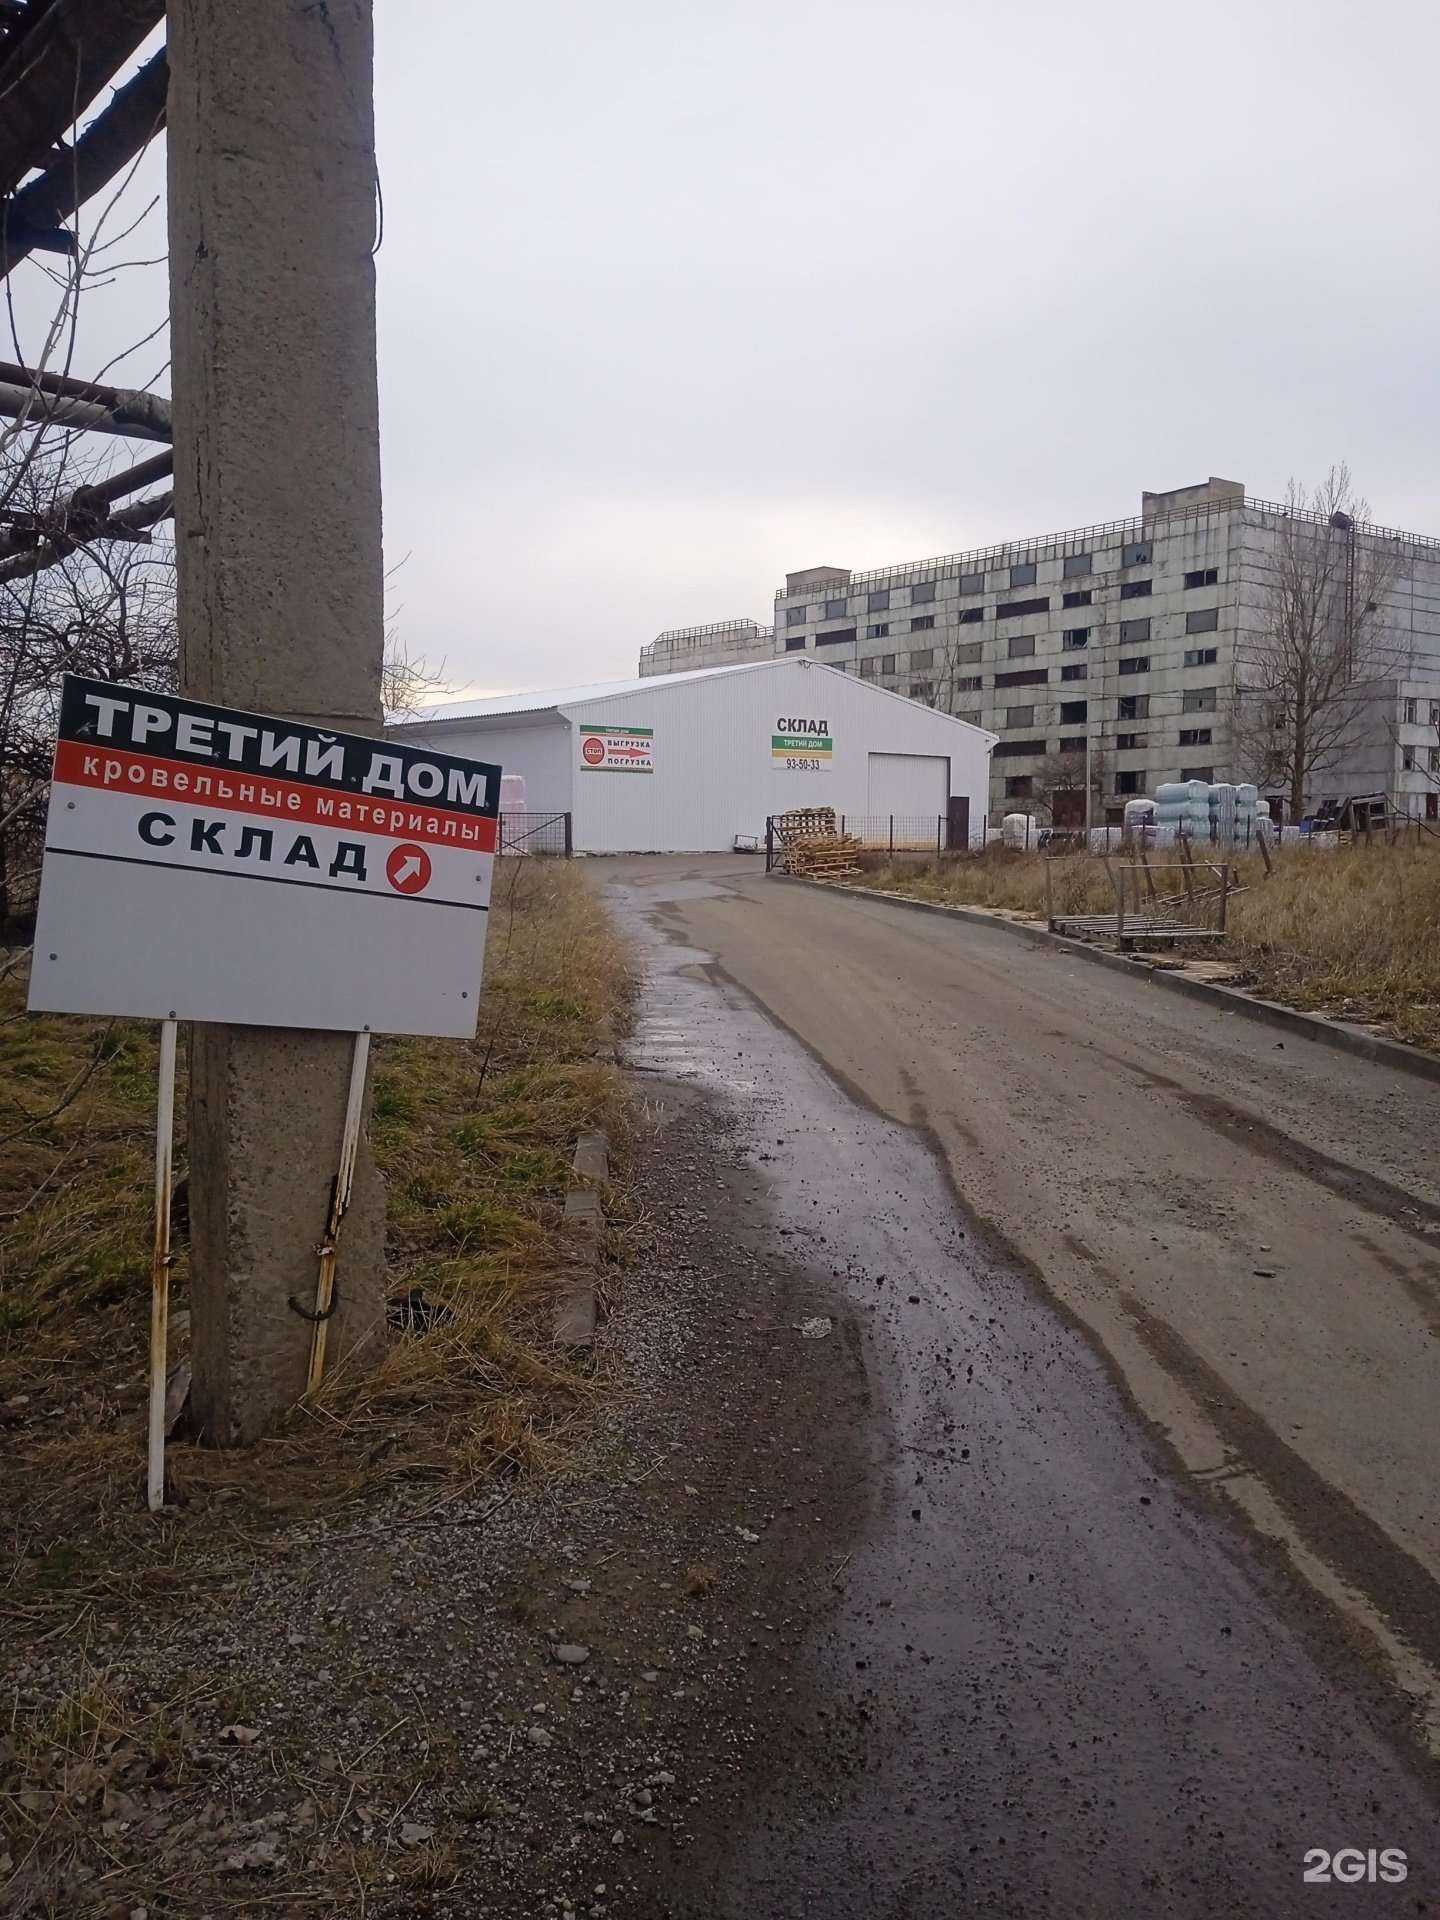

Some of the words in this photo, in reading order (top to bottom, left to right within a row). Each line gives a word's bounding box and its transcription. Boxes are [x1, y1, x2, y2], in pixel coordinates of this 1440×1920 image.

[607, 740, 650, 748] ВЫГРУЗКА
[777, 718, 829, 736] СКЛАД
[85, 694, 344, 781] ТРЕТИЙ
[362, 752, 488, 808] ДОМ
[607, 758, 652, 766] ПОГРУЗКА
[83, 756, 302, 812] кровельные
[316, 798, 481, 842] материалы
[137, 811, 368, 882] СКЛАД
